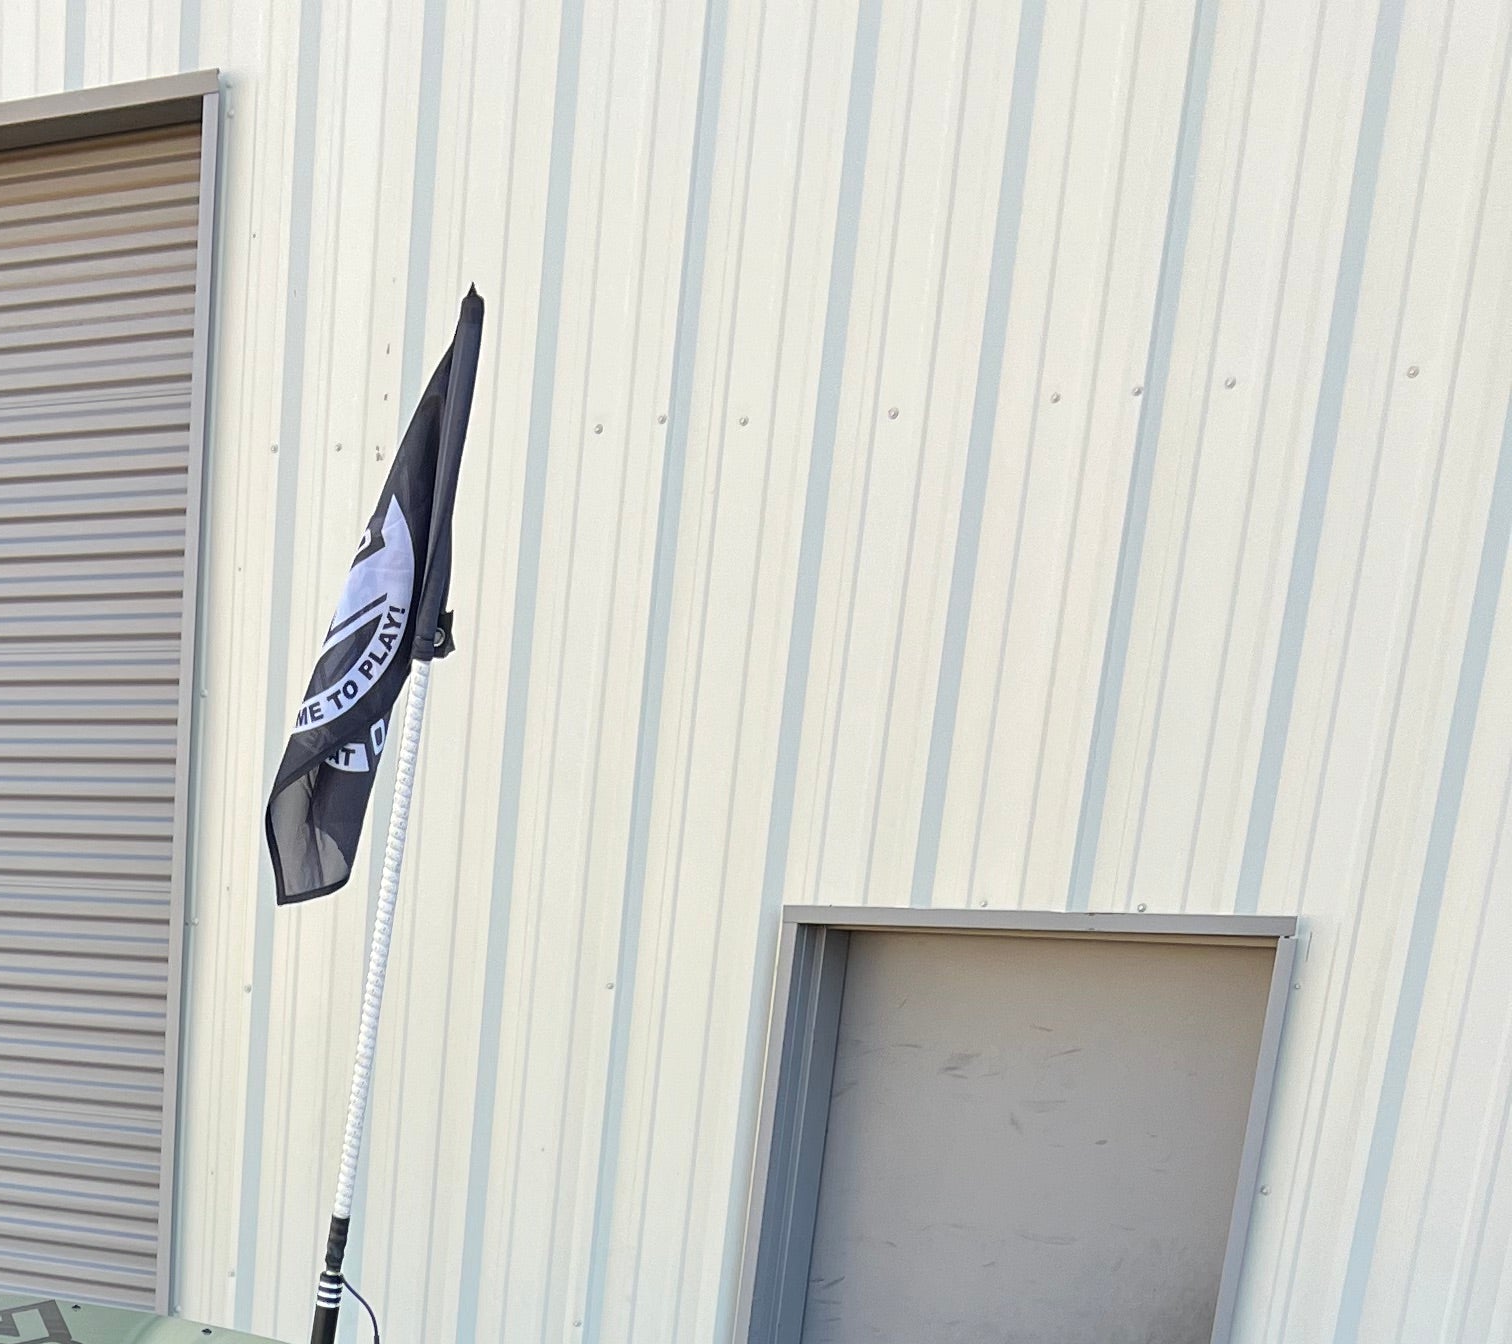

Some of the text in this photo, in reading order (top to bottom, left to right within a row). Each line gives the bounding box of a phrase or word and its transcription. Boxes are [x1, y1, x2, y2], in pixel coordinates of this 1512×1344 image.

[295, 704, 324, 729] ME
[326, 679, 359, 711] TO
[358, 605, 406, 681] PLAY!
